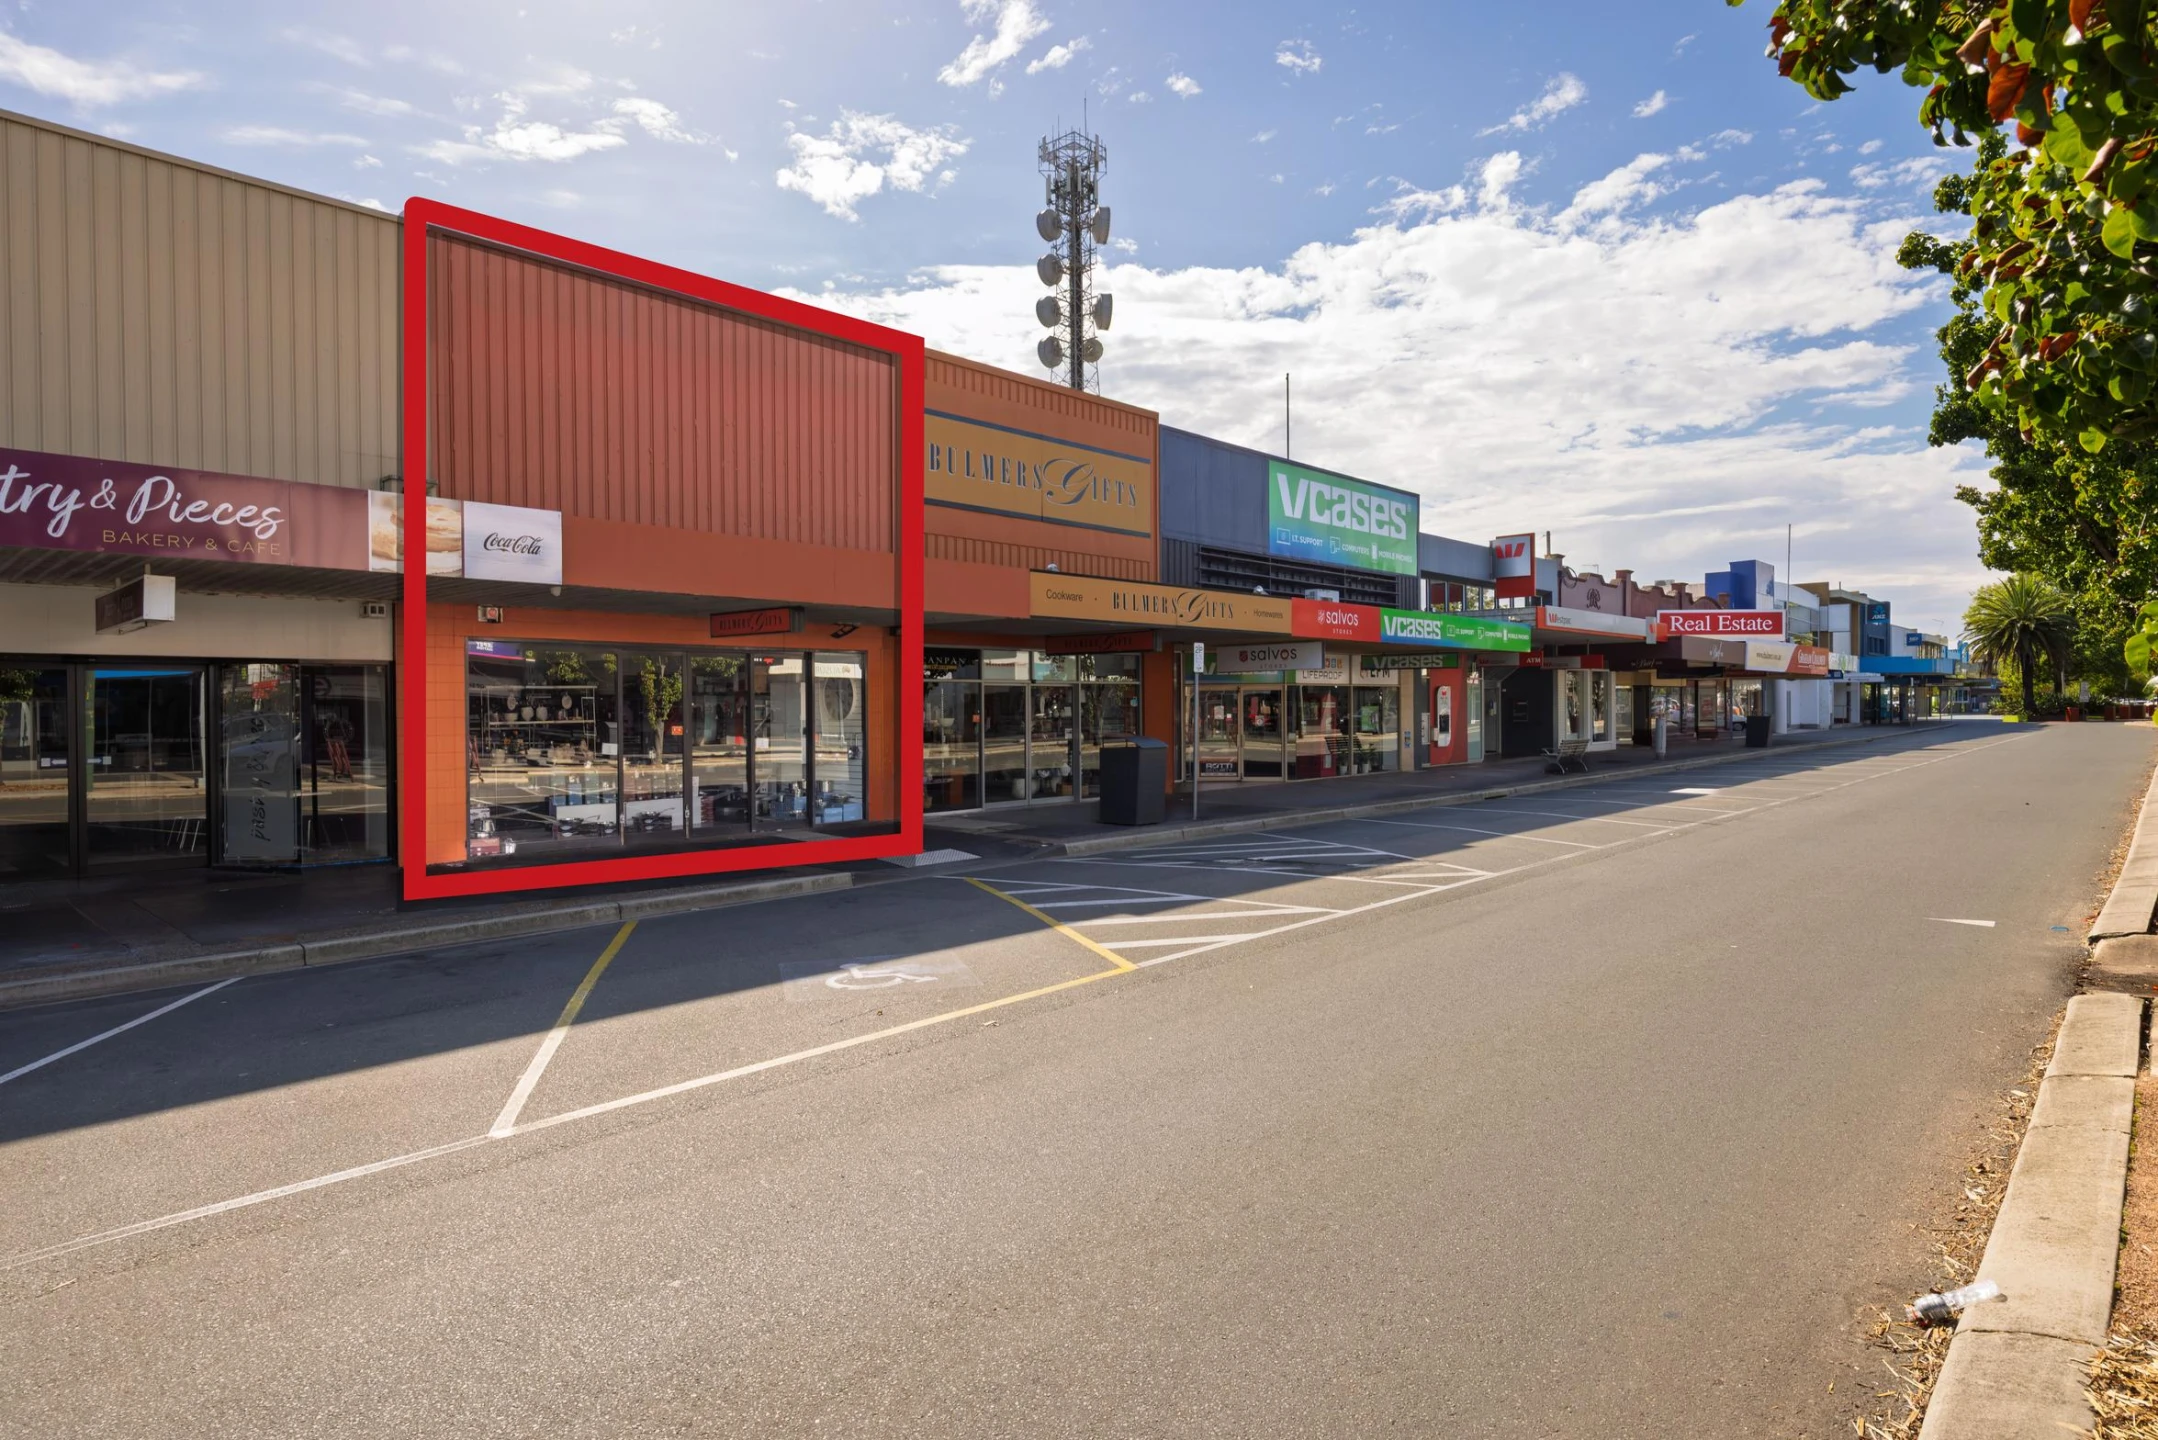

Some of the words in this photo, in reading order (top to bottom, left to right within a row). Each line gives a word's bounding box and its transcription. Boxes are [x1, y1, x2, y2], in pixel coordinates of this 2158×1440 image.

[928, 442, 1042, 490] BULMERS
[1042, 458, 1136, 508] GIFTS
[90, 478, 117, 510] &
[126, 475, 285, 540] Pieces
[103, 529, 195, 549] BAKERY
[205, 538, 218, 551] &
[227, 538, 280, 555] CAFE
[483, 532, 544, 555] Coca-Cola
[1300, 536, 1323, 547] SUPPORT
[1341, 543, 1370, 556] COMPUTERS
[1046, 589, 1083, 602] Cookware
[1113, 591, 1177, 614] BULMERS
[1176, 591, 1234, 623] GIFTS
[1253, 608, 1284, 619] Homewares
[1326, 609, 1359, 626] salvos
[1669, 615, 1710, 631] Real
[1717, 615, 1773, 631] Estate
[924, 656, 966, 666] ANPAN
[1250, 646, 1297, 661] salvos
[1302, 670, 1343, 680] LIFEPROOF
